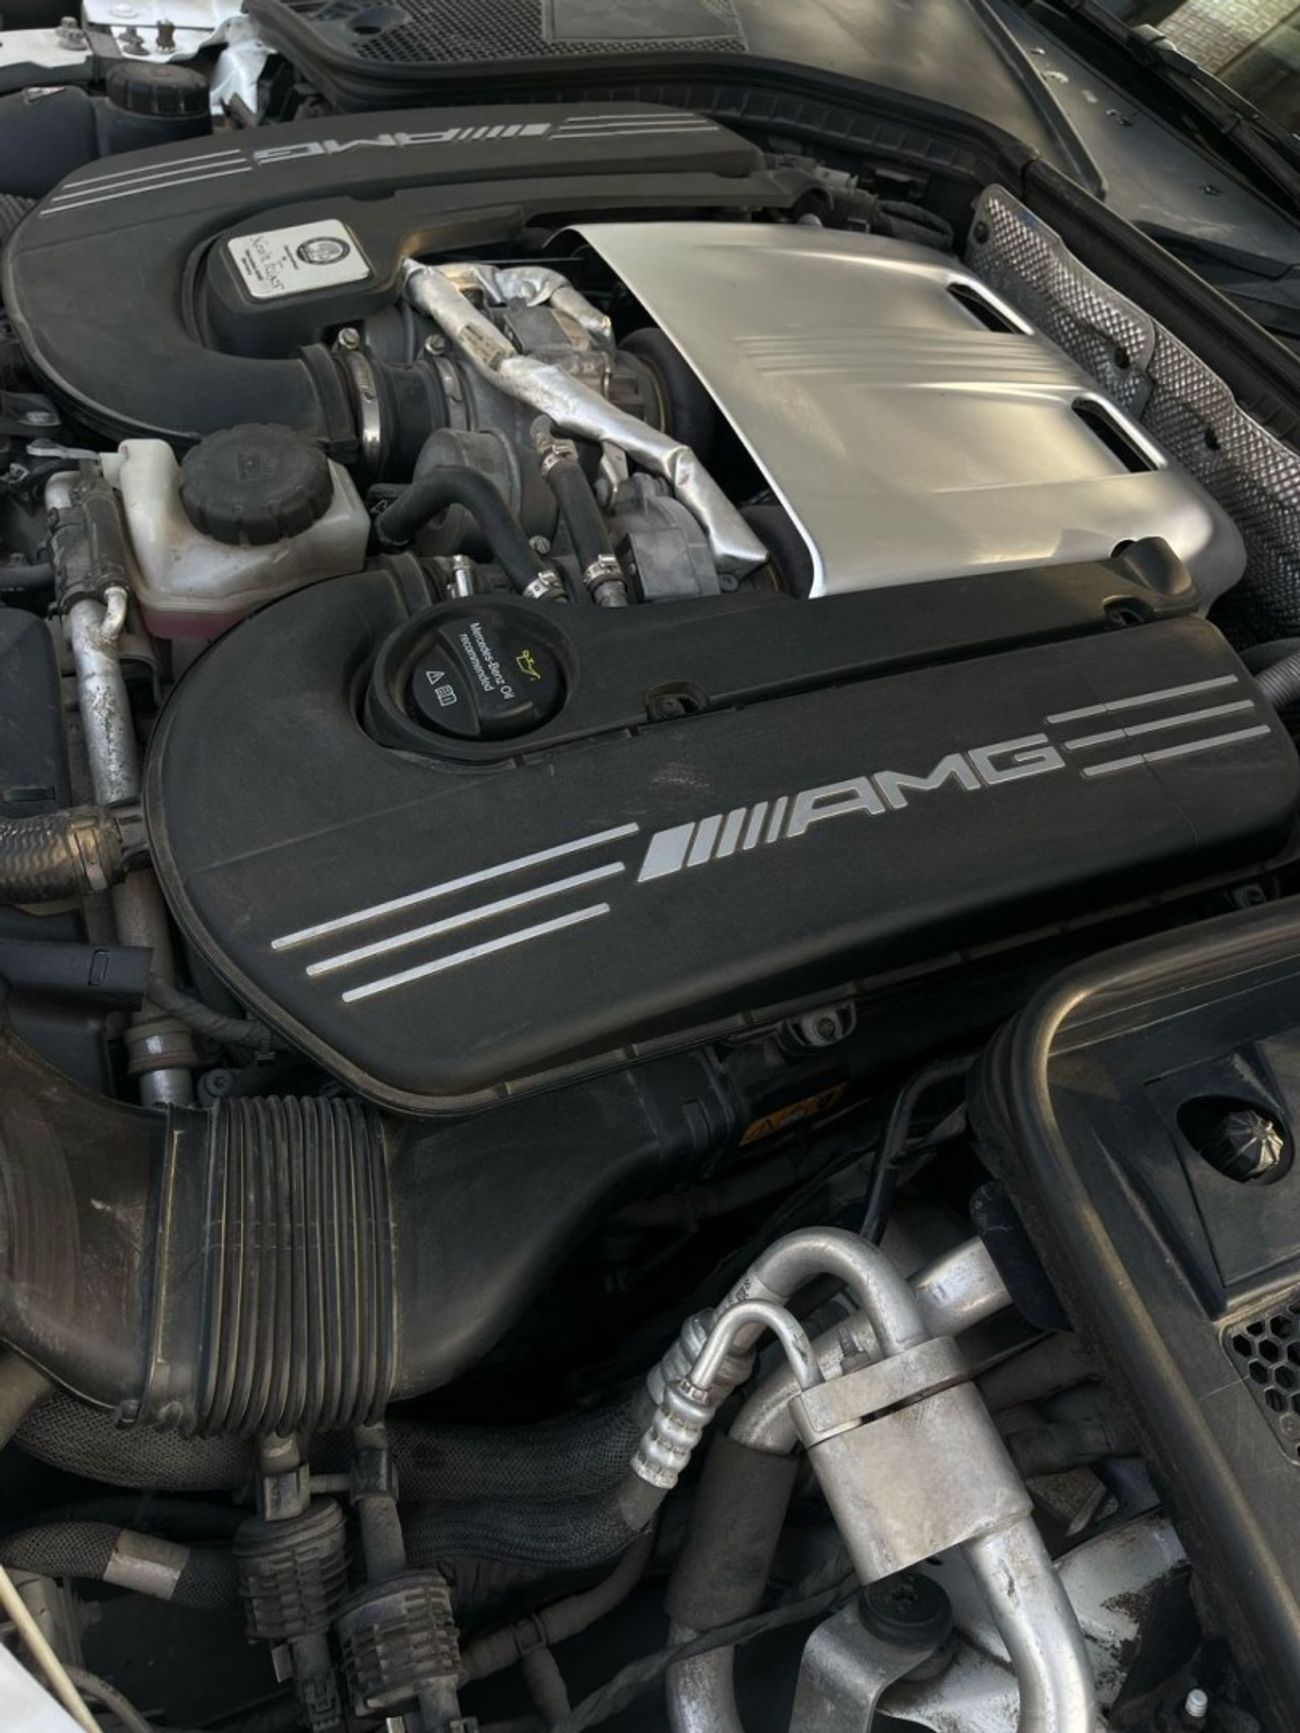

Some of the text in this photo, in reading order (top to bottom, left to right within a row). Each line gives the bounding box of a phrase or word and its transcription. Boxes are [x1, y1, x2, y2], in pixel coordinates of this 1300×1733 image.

[253, 127, 461, 165] AMG
[460, 633, 495, 692] recommended
[470, 622, 515, 700] Mercedes-Benz Oil
[787, 732, 1066, 838] AMG
